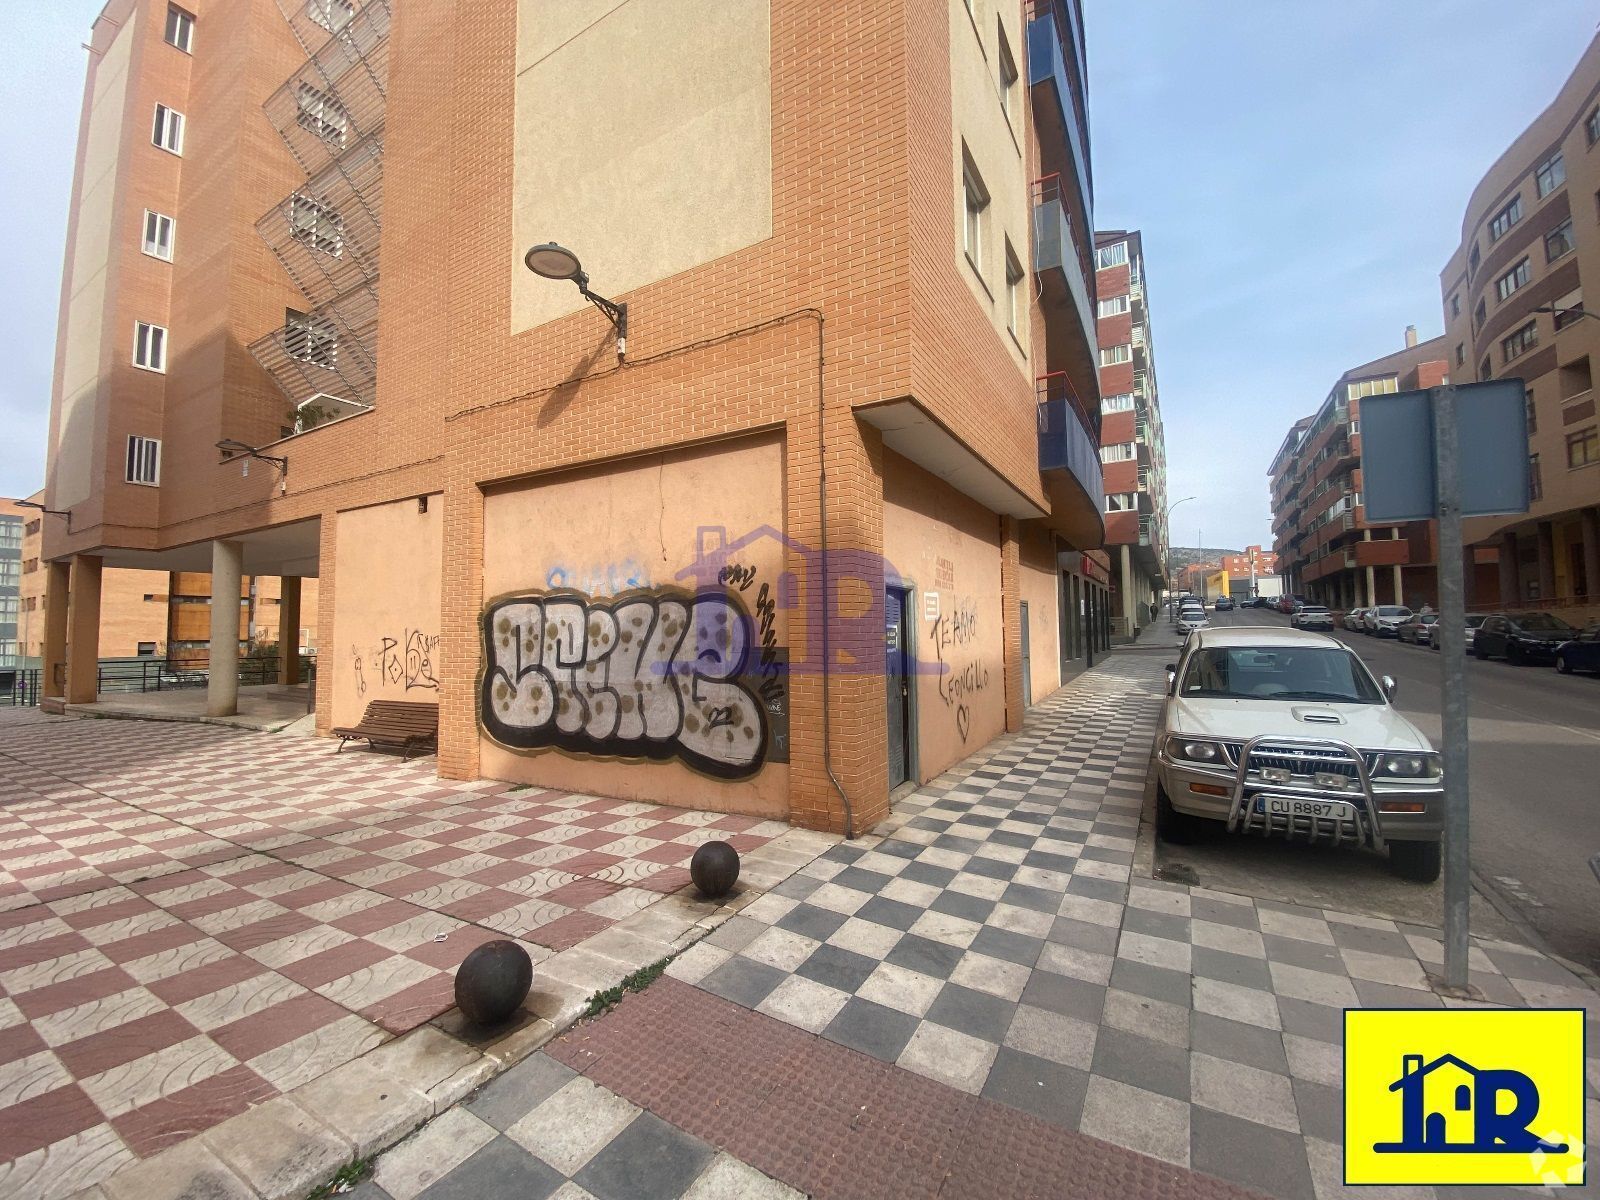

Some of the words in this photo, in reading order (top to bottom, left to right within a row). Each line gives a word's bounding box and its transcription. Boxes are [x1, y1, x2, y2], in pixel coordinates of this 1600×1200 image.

[1271, 801, 1290, 813] CU
[1293, 802, 1332, 817] 8887
[1336, 806, 1346, 817] J
